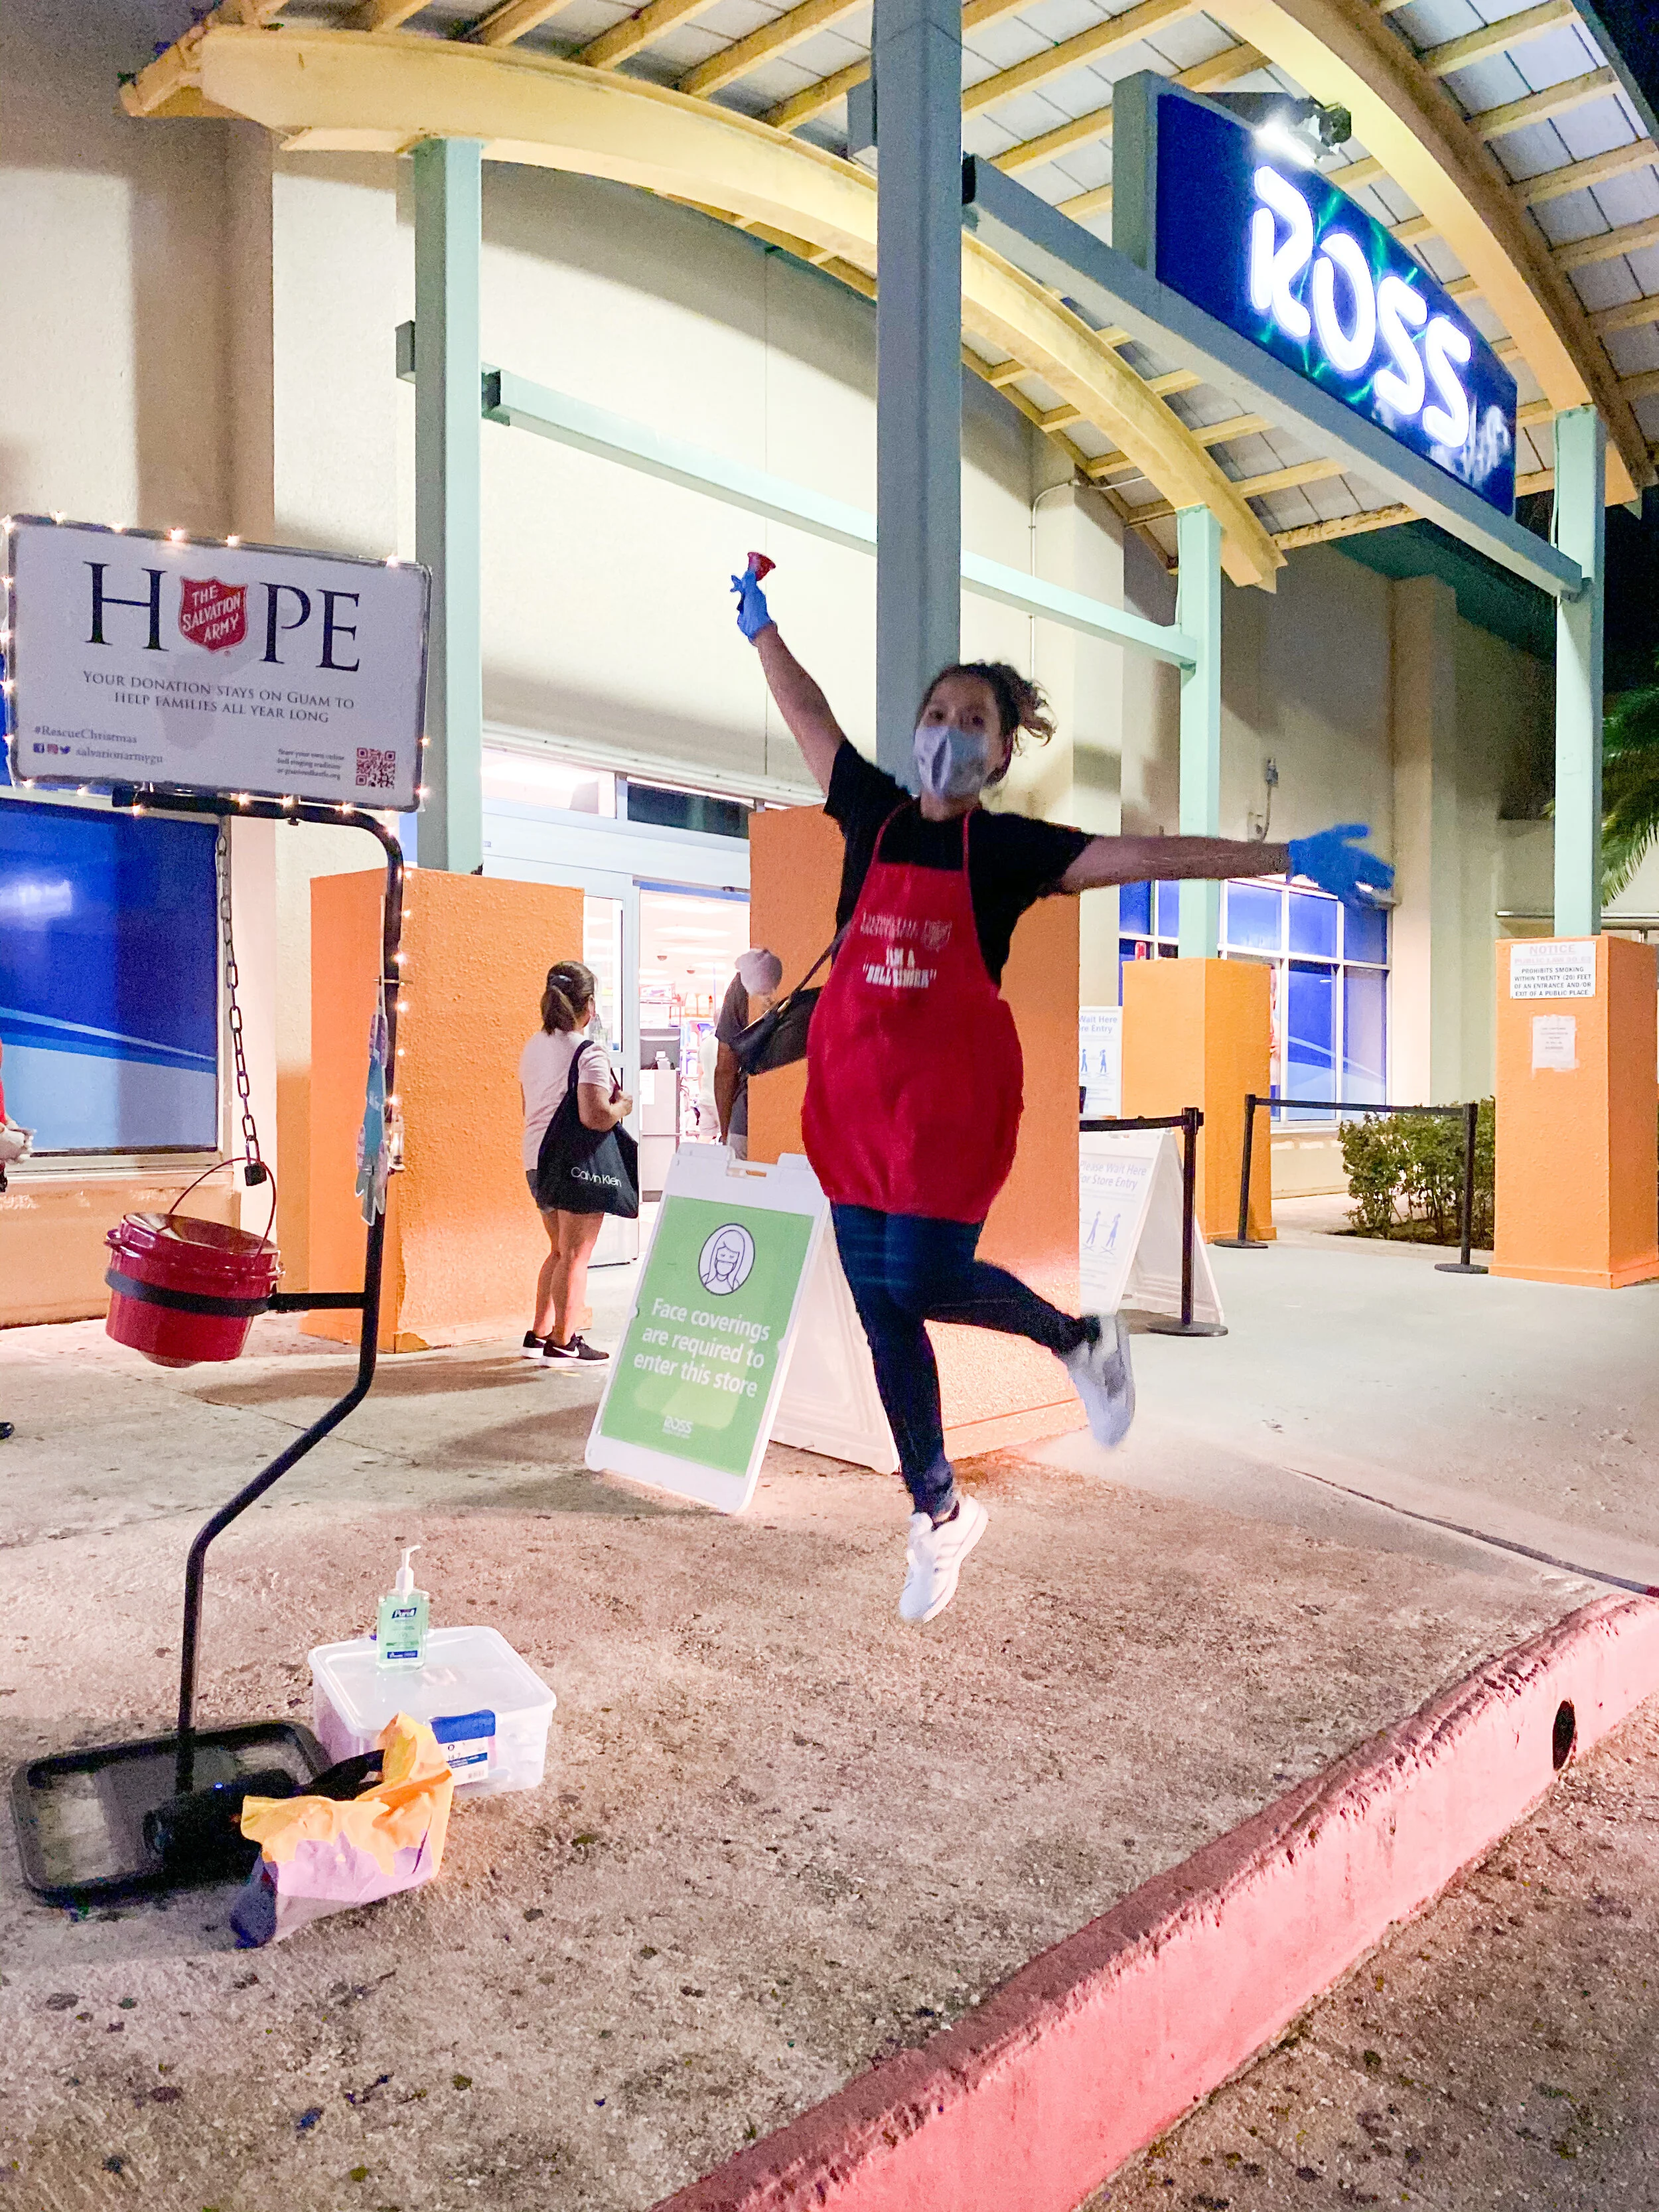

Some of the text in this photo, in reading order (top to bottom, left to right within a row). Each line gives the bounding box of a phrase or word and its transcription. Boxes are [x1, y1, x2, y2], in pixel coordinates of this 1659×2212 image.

[1251, 165, 1471, 449] ROSS
[192, 585, 218, 607] THE
[83, 560, 361, 672] HPE
[182, 591, 240, 632] SALVATION
[204, 613, 239, 642] ARMY
[83, 670, 354, 709] YOUR DONATION STAYS ON GUAM TO
[115, 692, 329, 723] HELP FAMILIES ALL YEAR LONG
[35, 725, 138, 744] #RescueChristmas
[1530, 944, 1575, 954] NOTICE
[1091, 1024, 1113, 1034] Entry
[1080, 1159, 1147, 1176] Please Wait Here
[1092, 1173, 1114, 1187] Store
[1115, 1176, 1138, 1191] Entry
[651, 1297, 771, 1344] Face coverings
[642, 1327, 764, 1368] are required to
[633, 1351, 758, 1398] enter this store
[664, 1416, 693, 1434] ROSS
